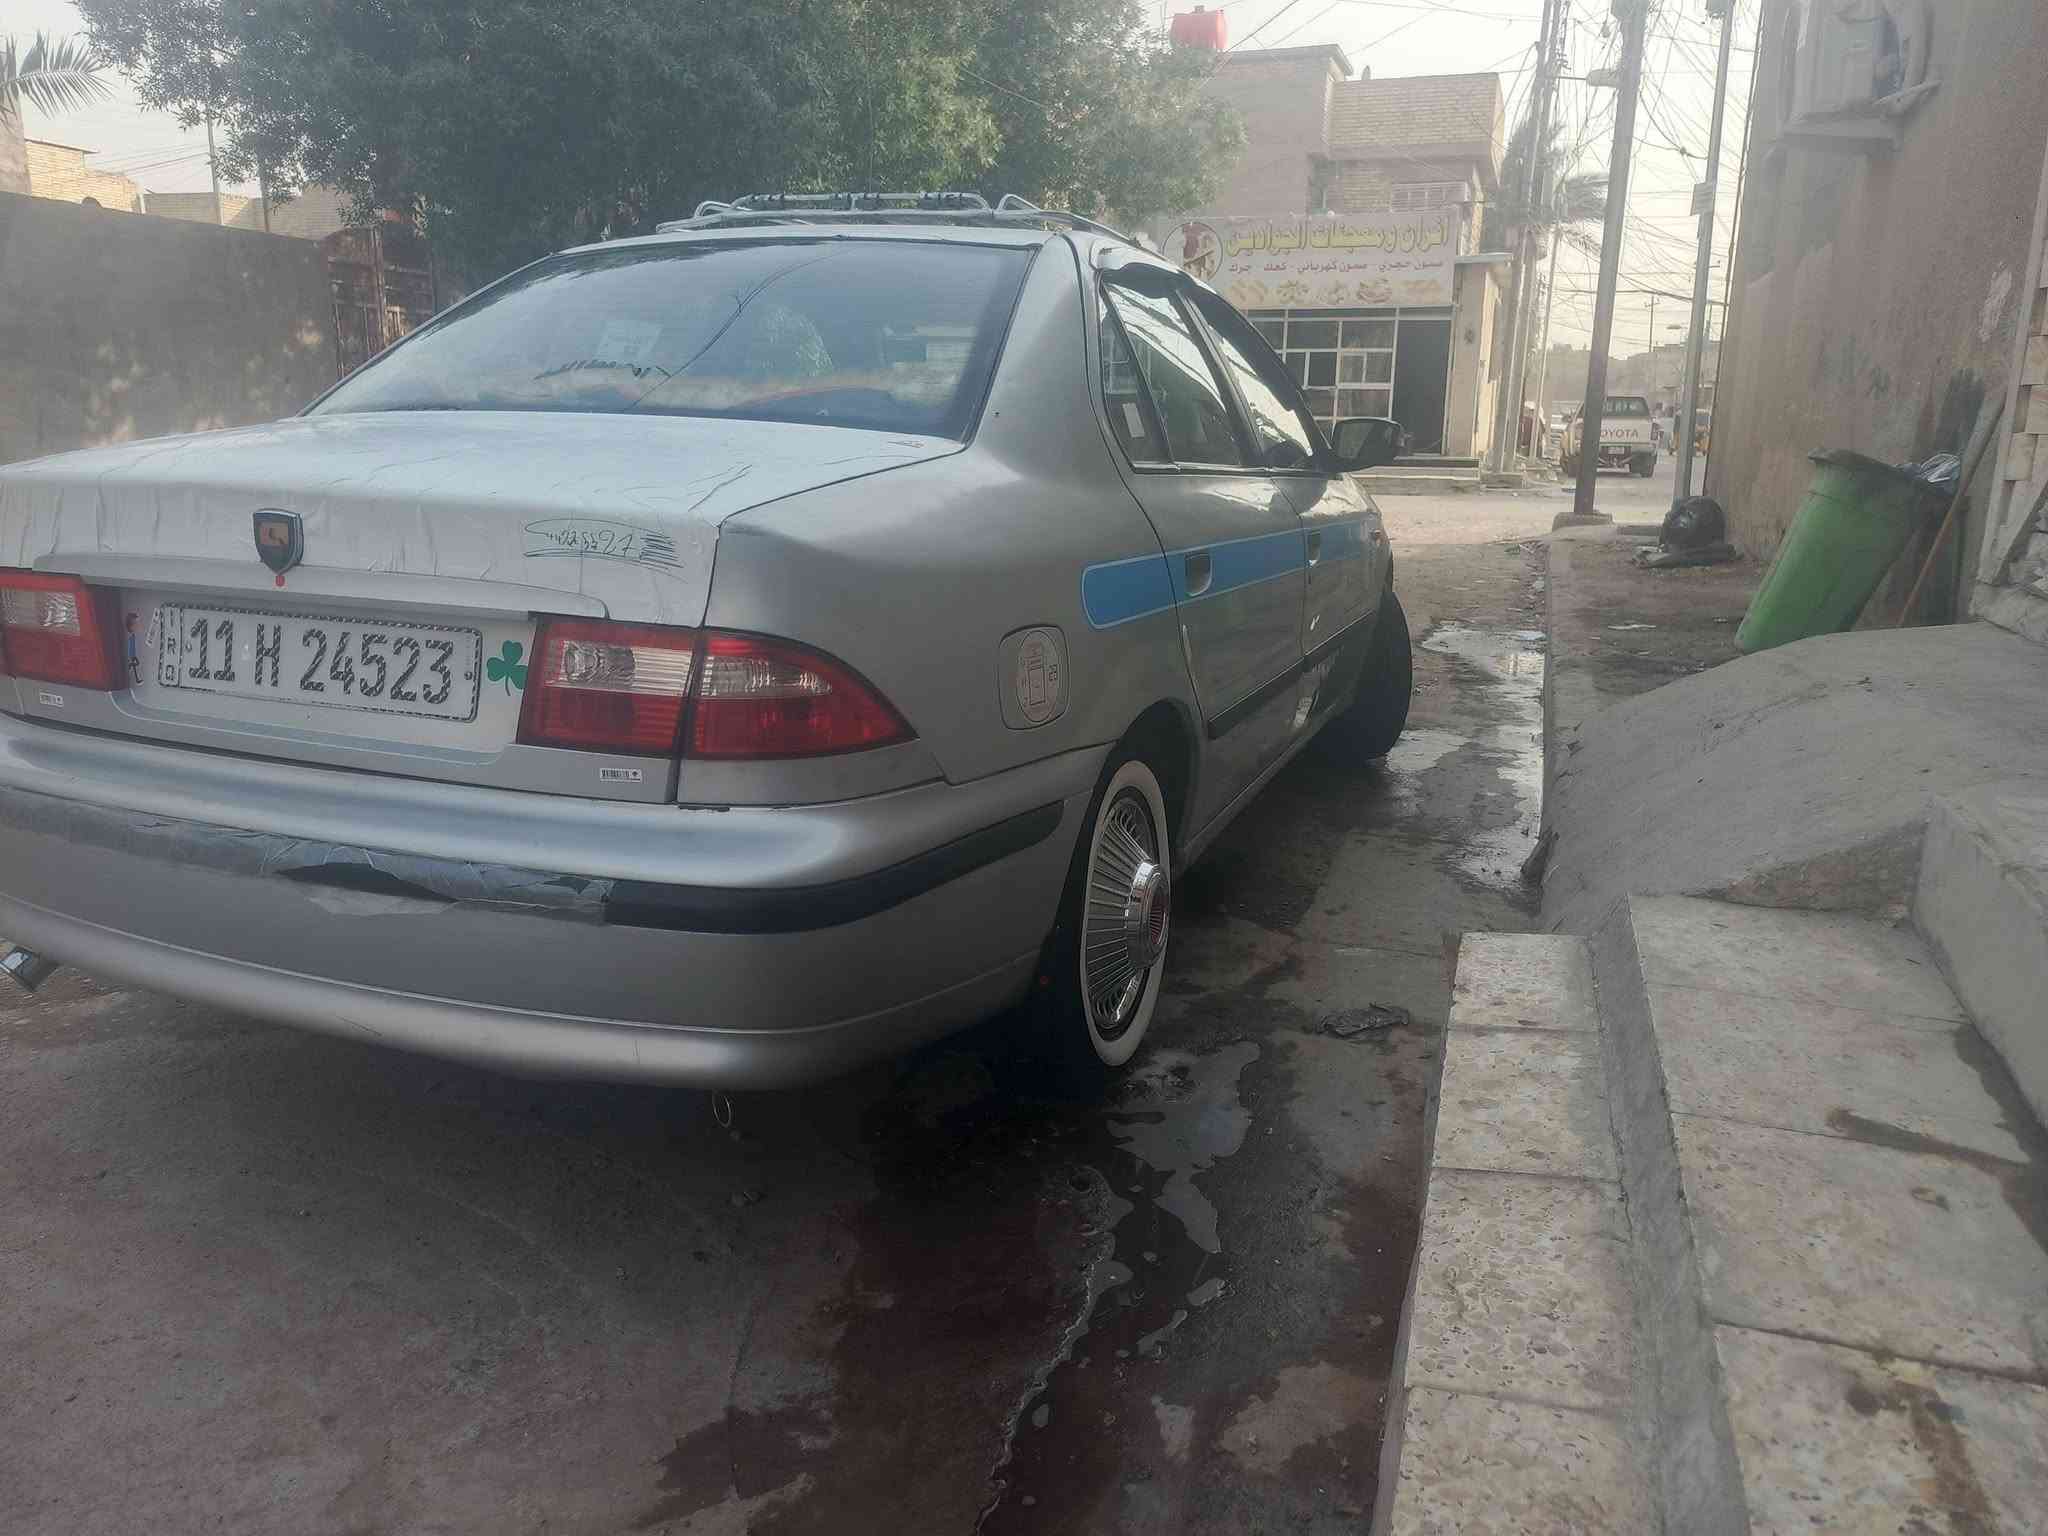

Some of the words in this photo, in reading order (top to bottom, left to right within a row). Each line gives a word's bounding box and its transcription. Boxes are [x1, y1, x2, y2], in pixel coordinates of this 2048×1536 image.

[1600, 428, 1639, 440] OYOTA
[188, 618, 235, 681] 11
[254, 623, 281, 687] H
[300, 628, 453, 704] 24523
